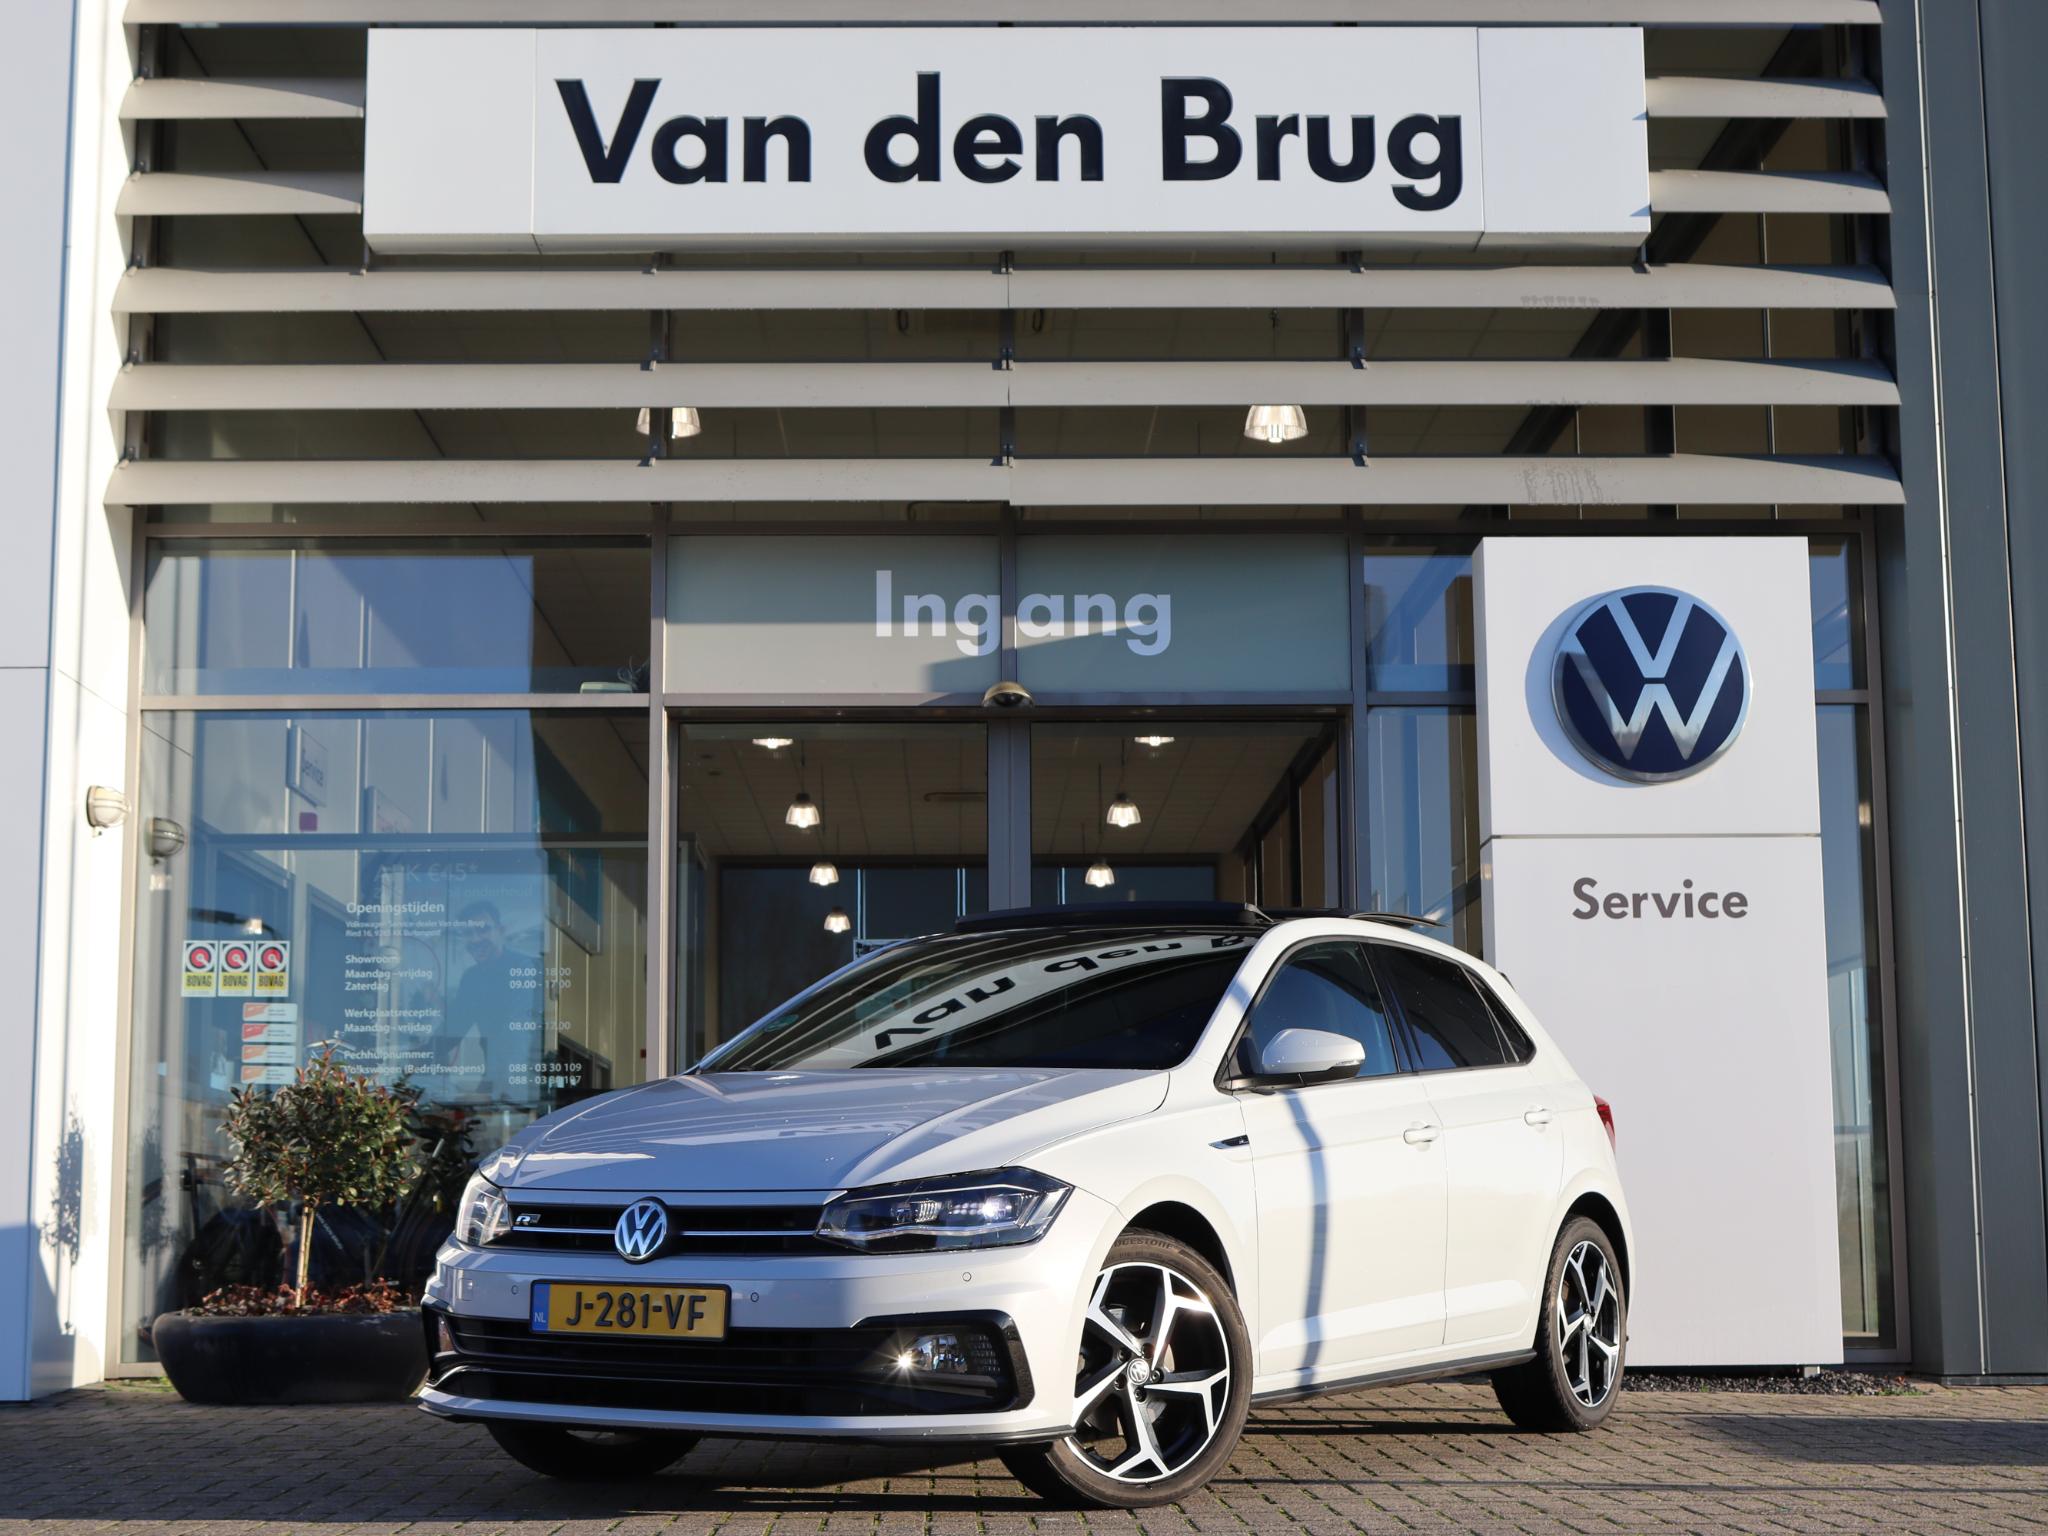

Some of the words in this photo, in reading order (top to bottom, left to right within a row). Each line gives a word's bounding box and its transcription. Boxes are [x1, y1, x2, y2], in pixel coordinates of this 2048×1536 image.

[555, 78, 811, 185] Van
[863, 71, 1104, 184] den
[1161, 77, 1464, 212] Brug
[875, 569, 1172, 657] Ingang
[373, 864, 420, 882] AK
[1572, 877, 1749, 920] Service
[346, 901, 445, 917] Openingstijden
[344, 969, 390, 980] Maandag
[398, 968, 432, 980] vrijdag
[510, 967, 537, 977] 09.00
[545, 967, 572, 977] 1800
[186, 975, 212, 987] BOVAG
[222, 975, 248, 987] BOVAG
[258, 975, 284, 987] BOVAG
[344, 982, 389, 992] Zaterdag
[510, 980, 536, 989] 09.00
[344, 1008, 441, 1020] Werkplaatsreceptie:
[344, 1023, 390, 1034] Maandag
[398, 1022, 432, 1034] vrijdag
[509, 1022, 536, 1031] 08.00
[404, 1063, 486, 1076] (Bedrijfswagens)
[508, 1063, 528, 1072] 088
[534, 1063, 547, 1072] 03
[550, 1063, 562, 1072] 30
[564, 1063, 582, 1072] 109
[508, 1076, 528, 1085] 088
[536, 1076, 547, 1085] 03
[534, 1311, 546, 1324] NL
[566, 1291, 707, 1331] J-281-VF
